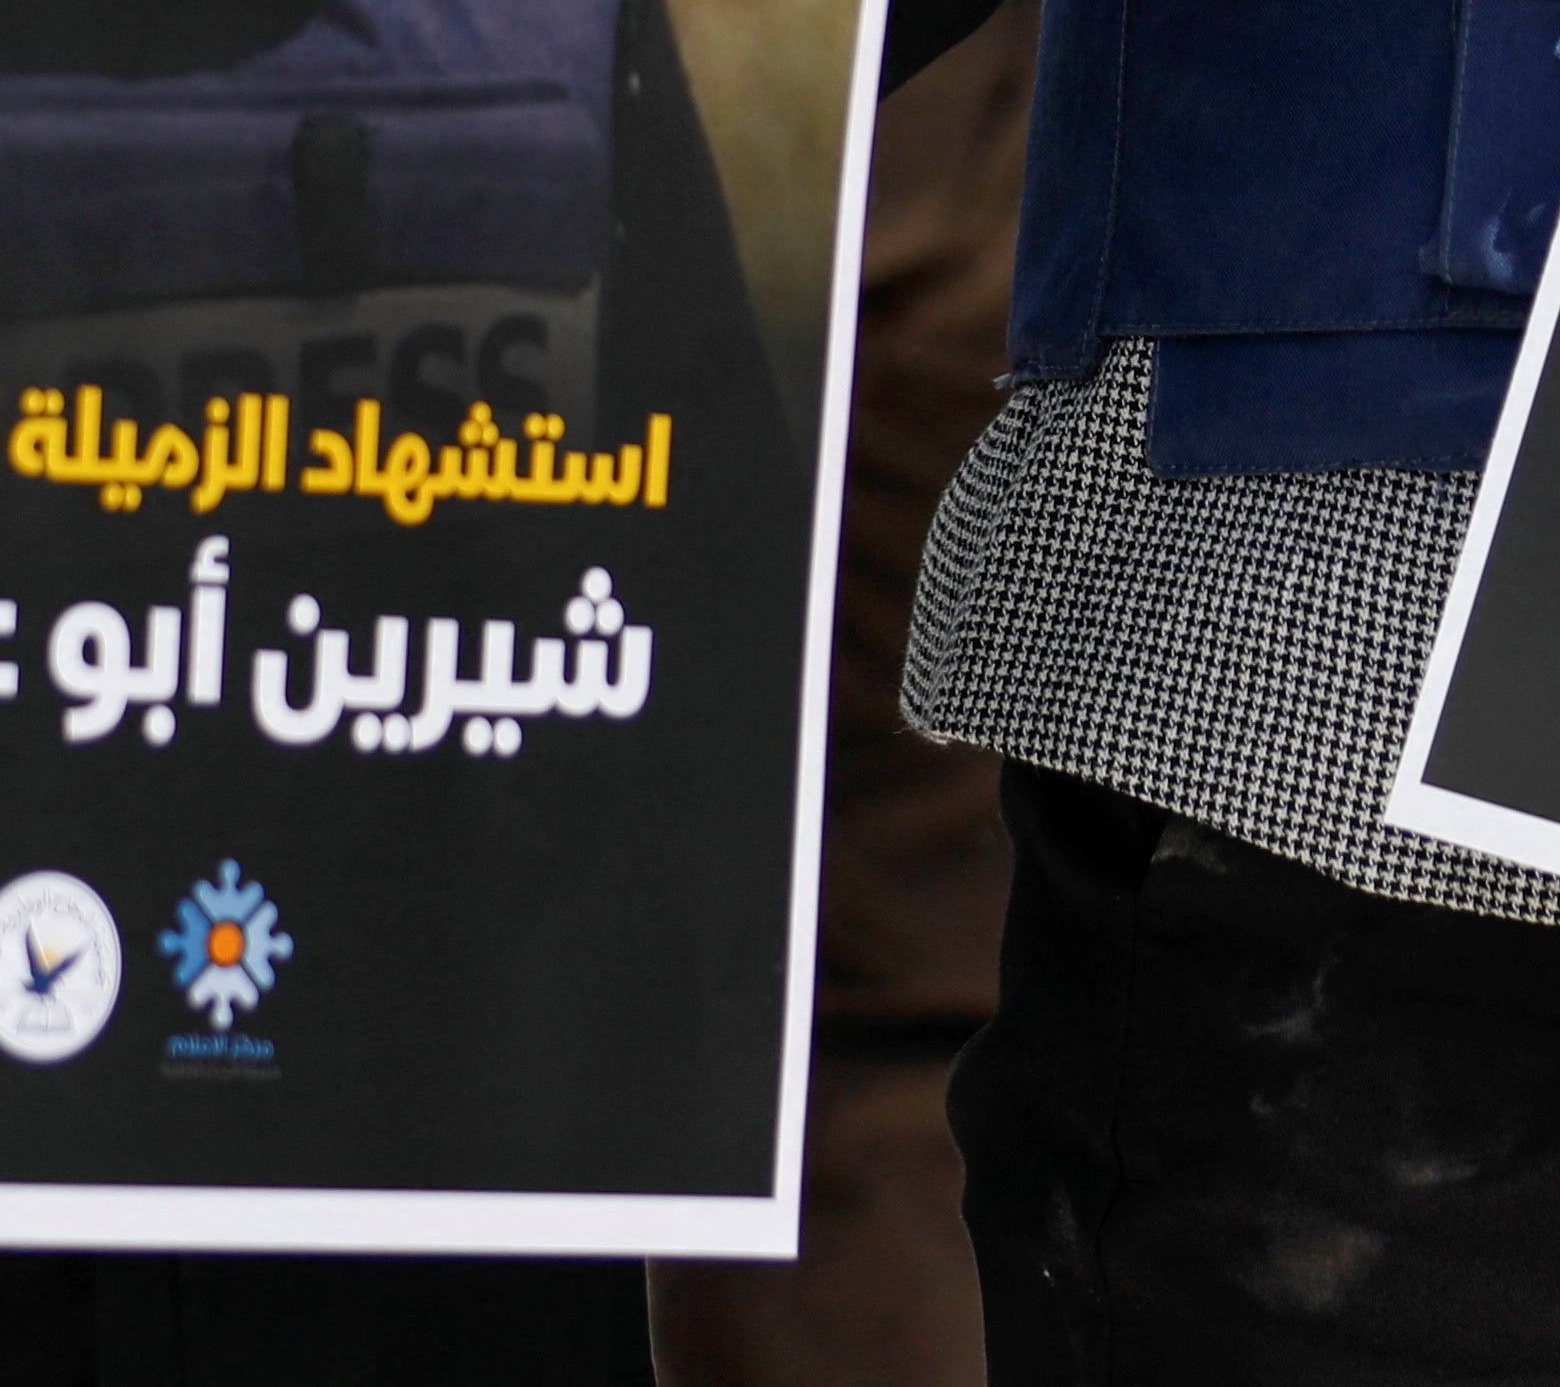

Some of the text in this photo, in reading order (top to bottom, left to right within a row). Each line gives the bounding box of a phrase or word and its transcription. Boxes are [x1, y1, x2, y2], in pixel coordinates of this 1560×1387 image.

[7, 384, 291, 514] الزميلة
[299, 398, 673, 527] استشهاد
[47, 535, 231, 746] أبو
[251, 566, 654, 757] شيرين
